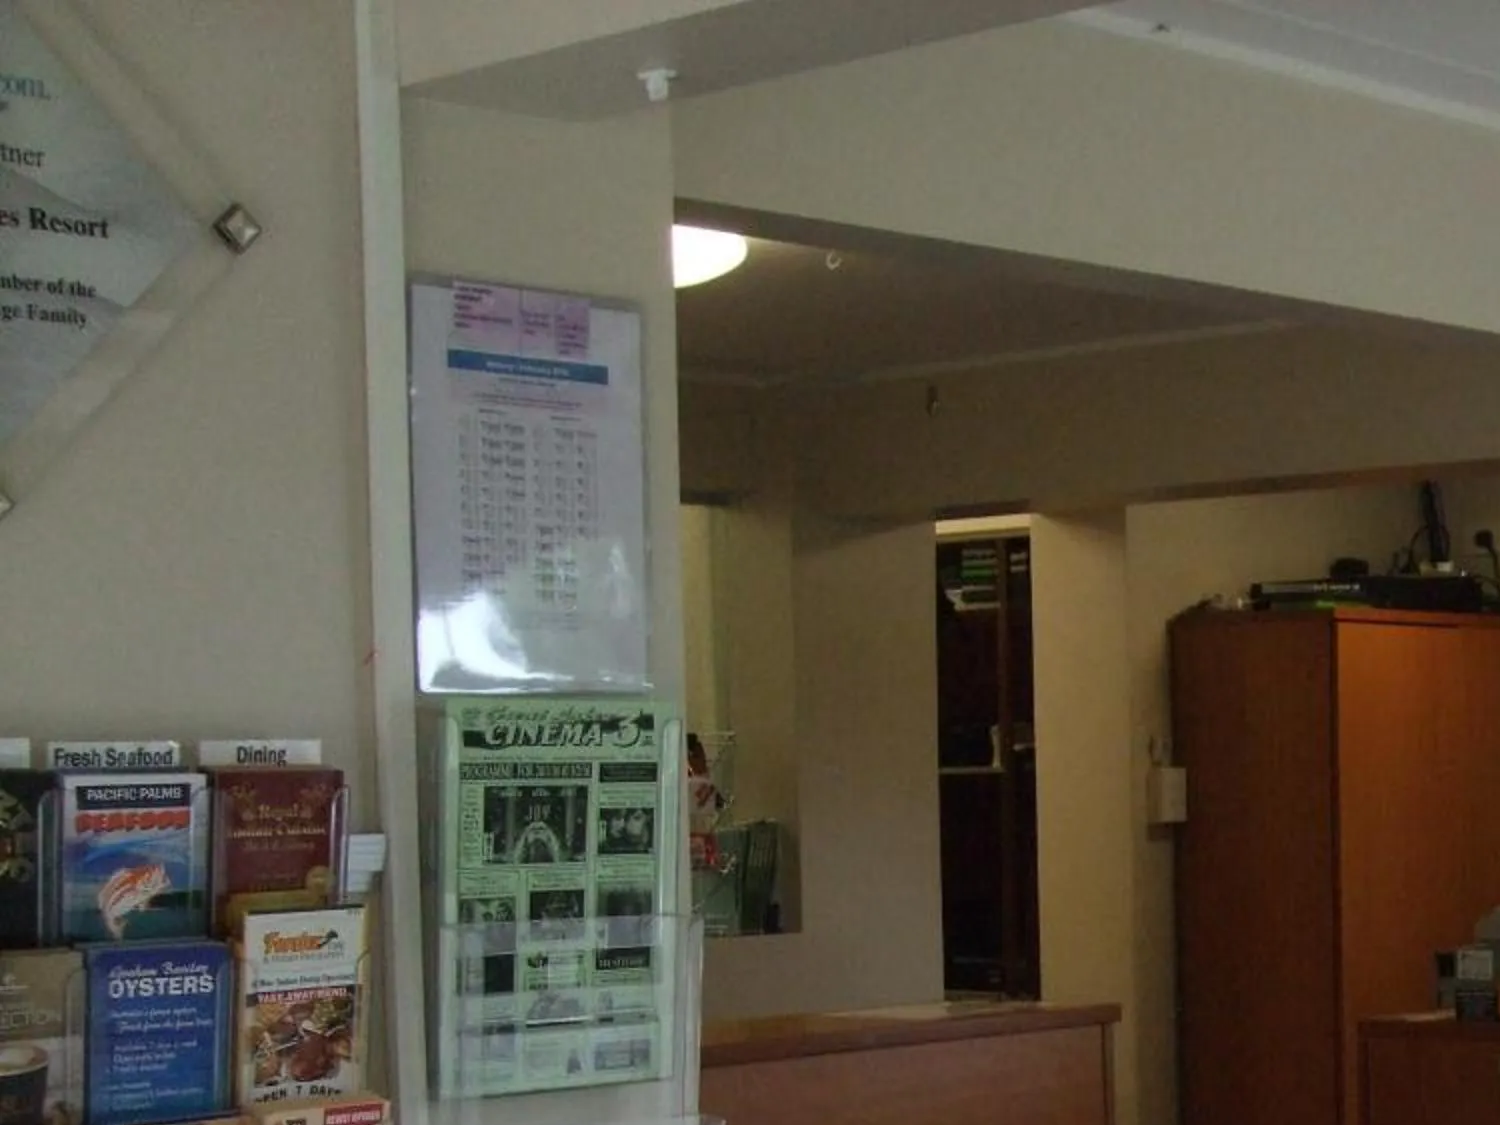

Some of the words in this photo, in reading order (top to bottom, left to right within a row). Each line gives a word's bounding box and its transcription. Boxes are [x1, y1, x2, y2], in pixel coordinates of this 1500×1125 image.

[29, 206, 109, 238] Resort
[47, 279, 65, 297] of
[69, 281, 97, 299] the
[28, 303, 87, 329] Family
[483, 721, 604, 749] CINEMA
[54, 748, 101, 767] Fresh
[105, 747, 173, 767] Seafood
[237, 745, 287, 768] Dining
[87, 787, 136, 801] PACIFIC
[140, 786, 182, 800] PALMS
[108, 974, 215, 1000] OYSTERS
